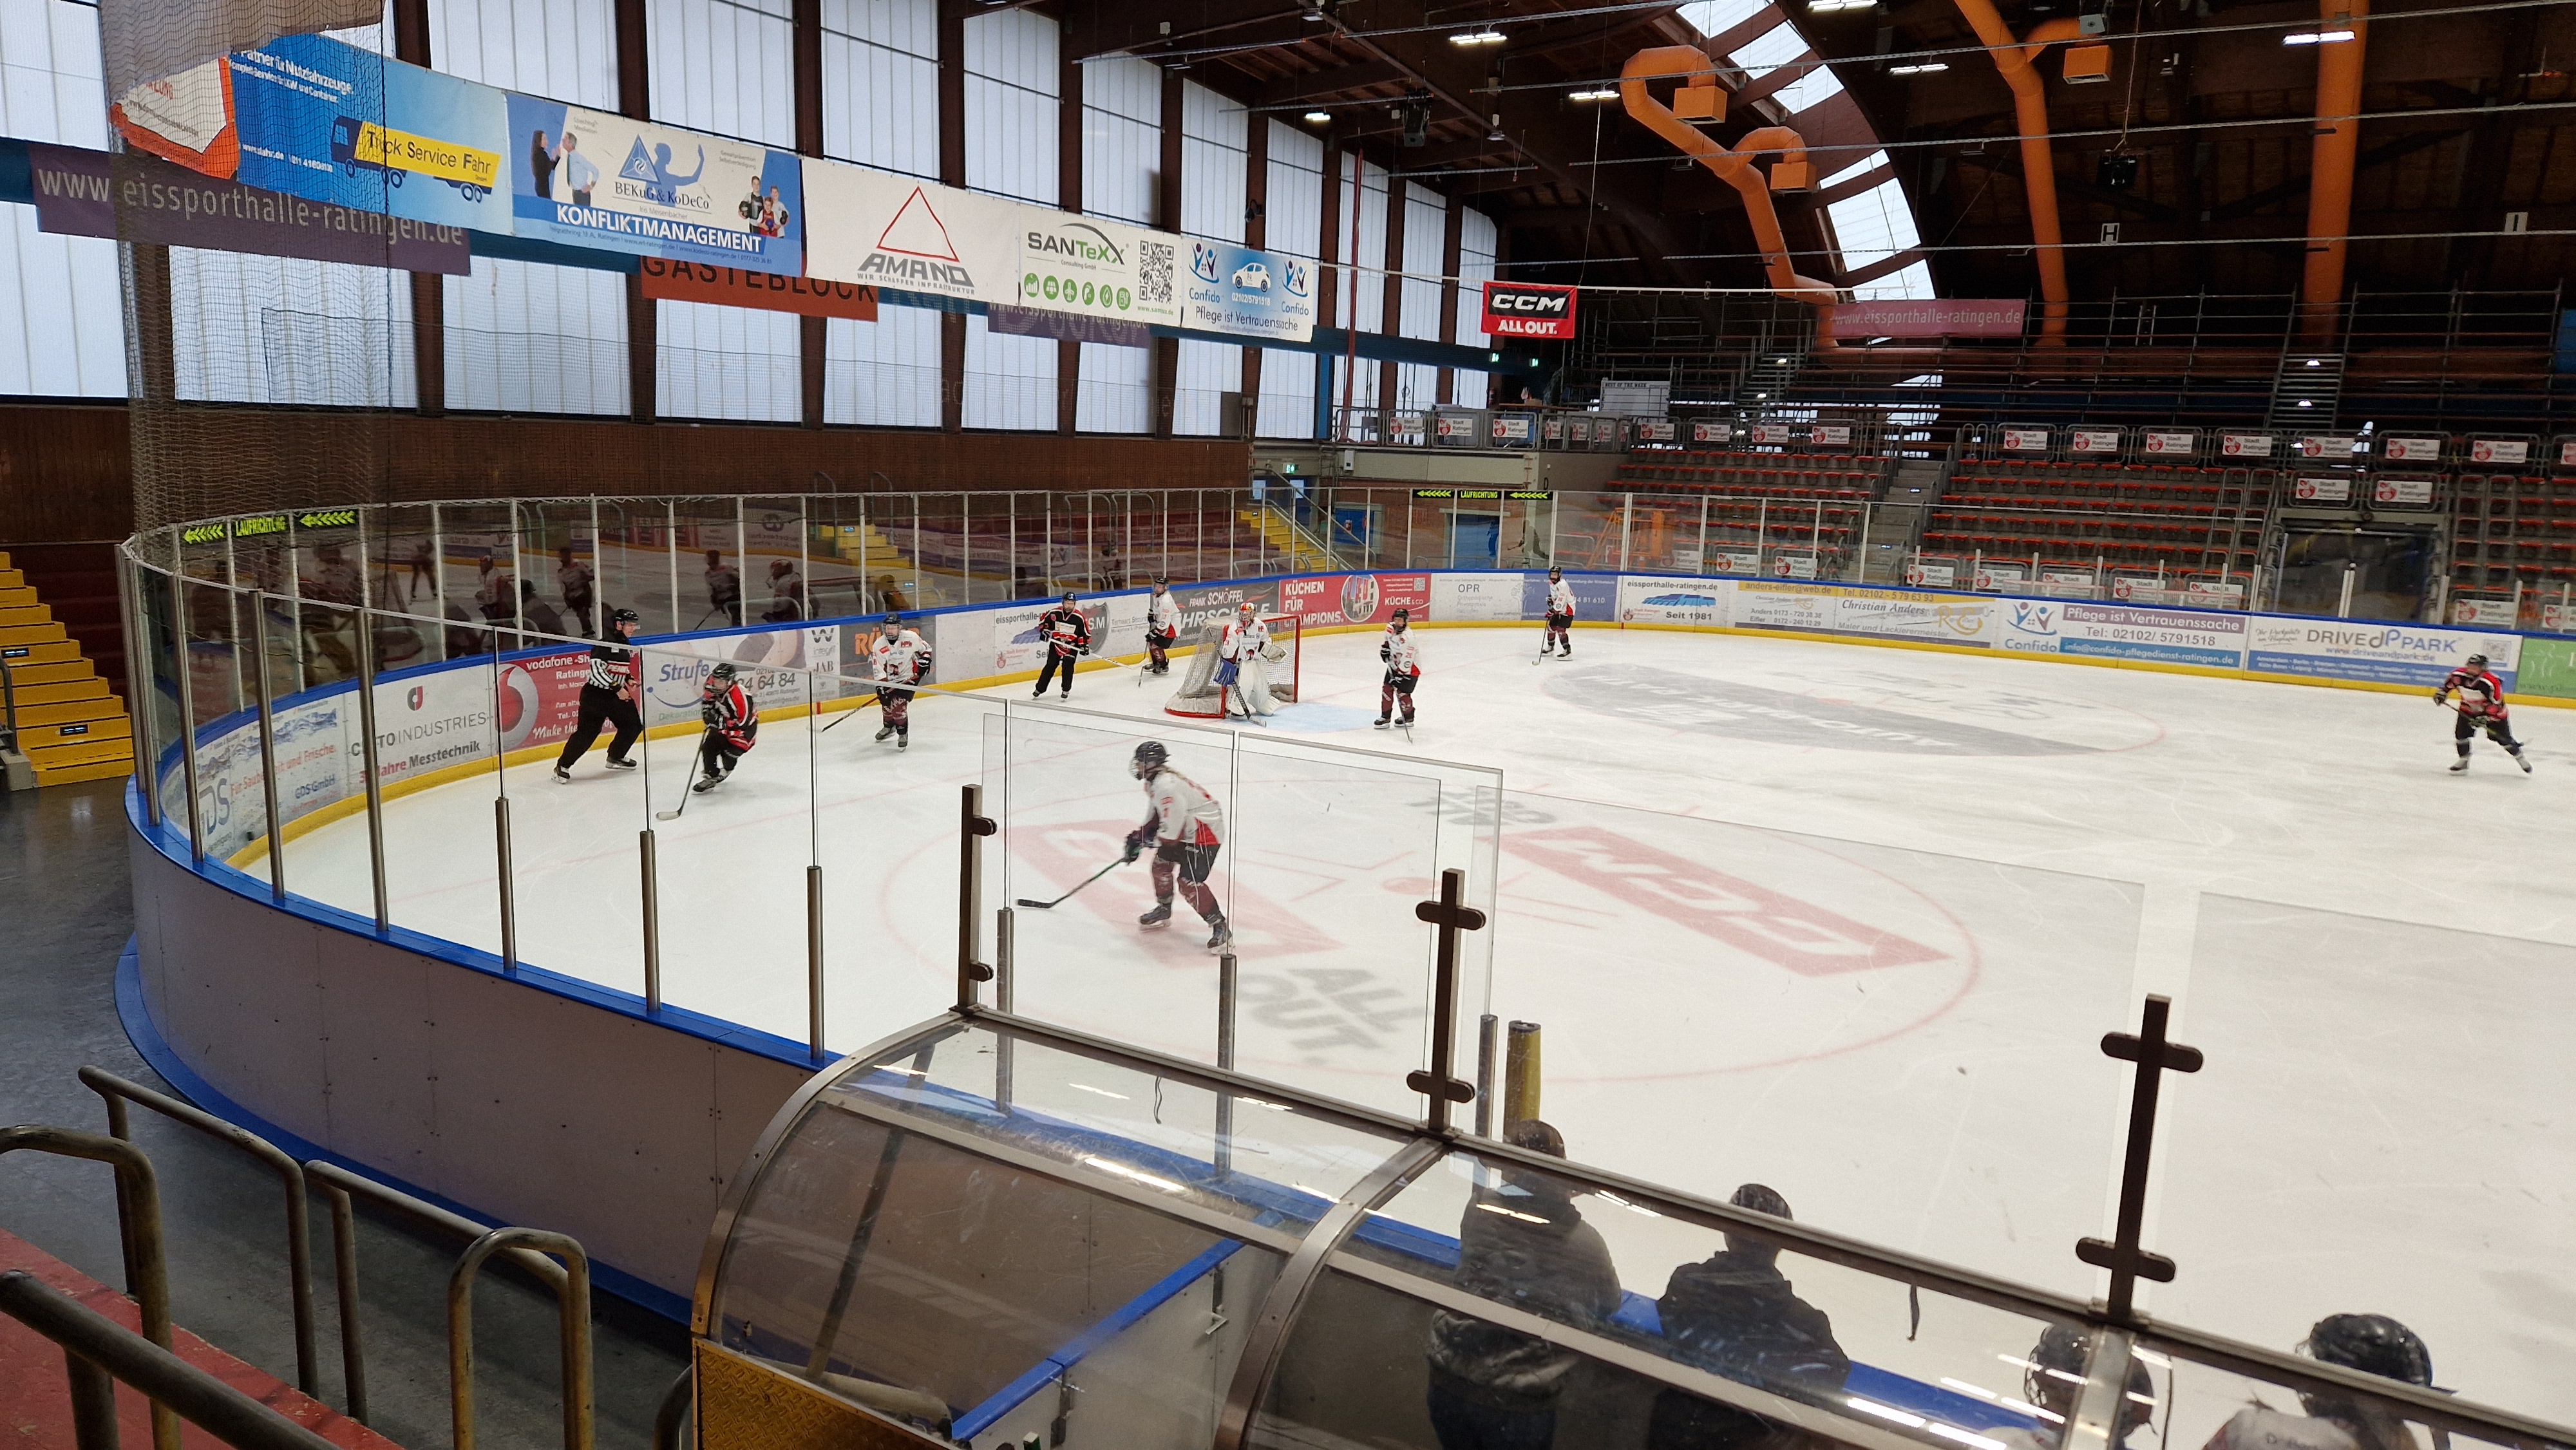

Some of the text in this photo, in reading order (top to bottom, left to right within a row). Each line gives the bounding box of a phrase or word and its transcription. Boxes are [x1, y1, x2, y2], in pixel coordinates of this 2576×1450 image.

[407, 141, 457, 168] Service
[462, 153, 491, 174] Fahr
[615, 181, 709, 209] BEKuG & KoDeCo
[639, 205, 688, 220] Iris Meisenbacher
[556, 203, 762, 252] KONFLIKTMANAGEMENT
[2103, 225, 2117, 242] H
[858, 252, 975, 288] AMAND
[1061, 259, 1084, 270] Consulting
[857, 272, 975, 295] WIR SCHAFFEN INFRASTRUKTUR
[1189, 287, 1220, 303] Confido
[1232, 292, 1271, 306] 02102/5791518
[1492, 294, 1566, 312] CCM
[1281, 301, 1309, 315] Confido
[1196, 306, 1222, 325] Pflege
[1236, 312, 1298, 331] Vertrauenssache
[1835, 308, 2020, 327] www.eissporthalle-ratingen.de
[1498, 320, 1557, 335] ALL OUT.
[1461, 490, 1498, 500] LAUFRICHTUNG
[1926, 574, 1952, 582] Ratingen
[1285, 579, 1324, 596] KÜCHEN
[1458, 584, 1480, 593] OPR
[1627, 581, 1718, 592] eissporthalle-ratingen.de
[1745, 582, 1832, 594] anders-eifler@web.de
[1189, 588, 1244, 607] FRANK SCHÖFFEL
[1385, 597, 1411, 606] KÜCHE
[1843, 588, 1855, 596] Tel.
[1859, 590, 1884, 599] 02102
[1899, 592, 1909, 601] 79
[1911, 593, 1921, 601] 63
[1924, 594, 1935, 603] 93
[1285, 596, 1303, 612] FÜR
[1842, 599, 1926, 615] Christian Anders
[1665, 611, 1712, 621] Seit 1981
[2066, 607, 2240, 632] Pflege ist Vertrauenssache
[1837, 622, 1861, 630] Maler
[1880, 625, 1949, 638] Lackierermeister
[2086, 626, 2215, 646] Tel: 02102/ 5791518
[2005, 638, 2058, 653] Confido
[2065, 643, 2234, 665] info@confido-pflegedienst-ratingen.de
[2326, 647, 2436, 662] www.driveandpark.de
[526, 656, 573, 670] vodafone
[813, 661, 834, 673] JAB
[659, 659, 709, 686] Strufe
[757, 673, 796, 690] 64 84
[533, 724, 562, 740] Make
[409, 740, 480, 769] Messtechnik
